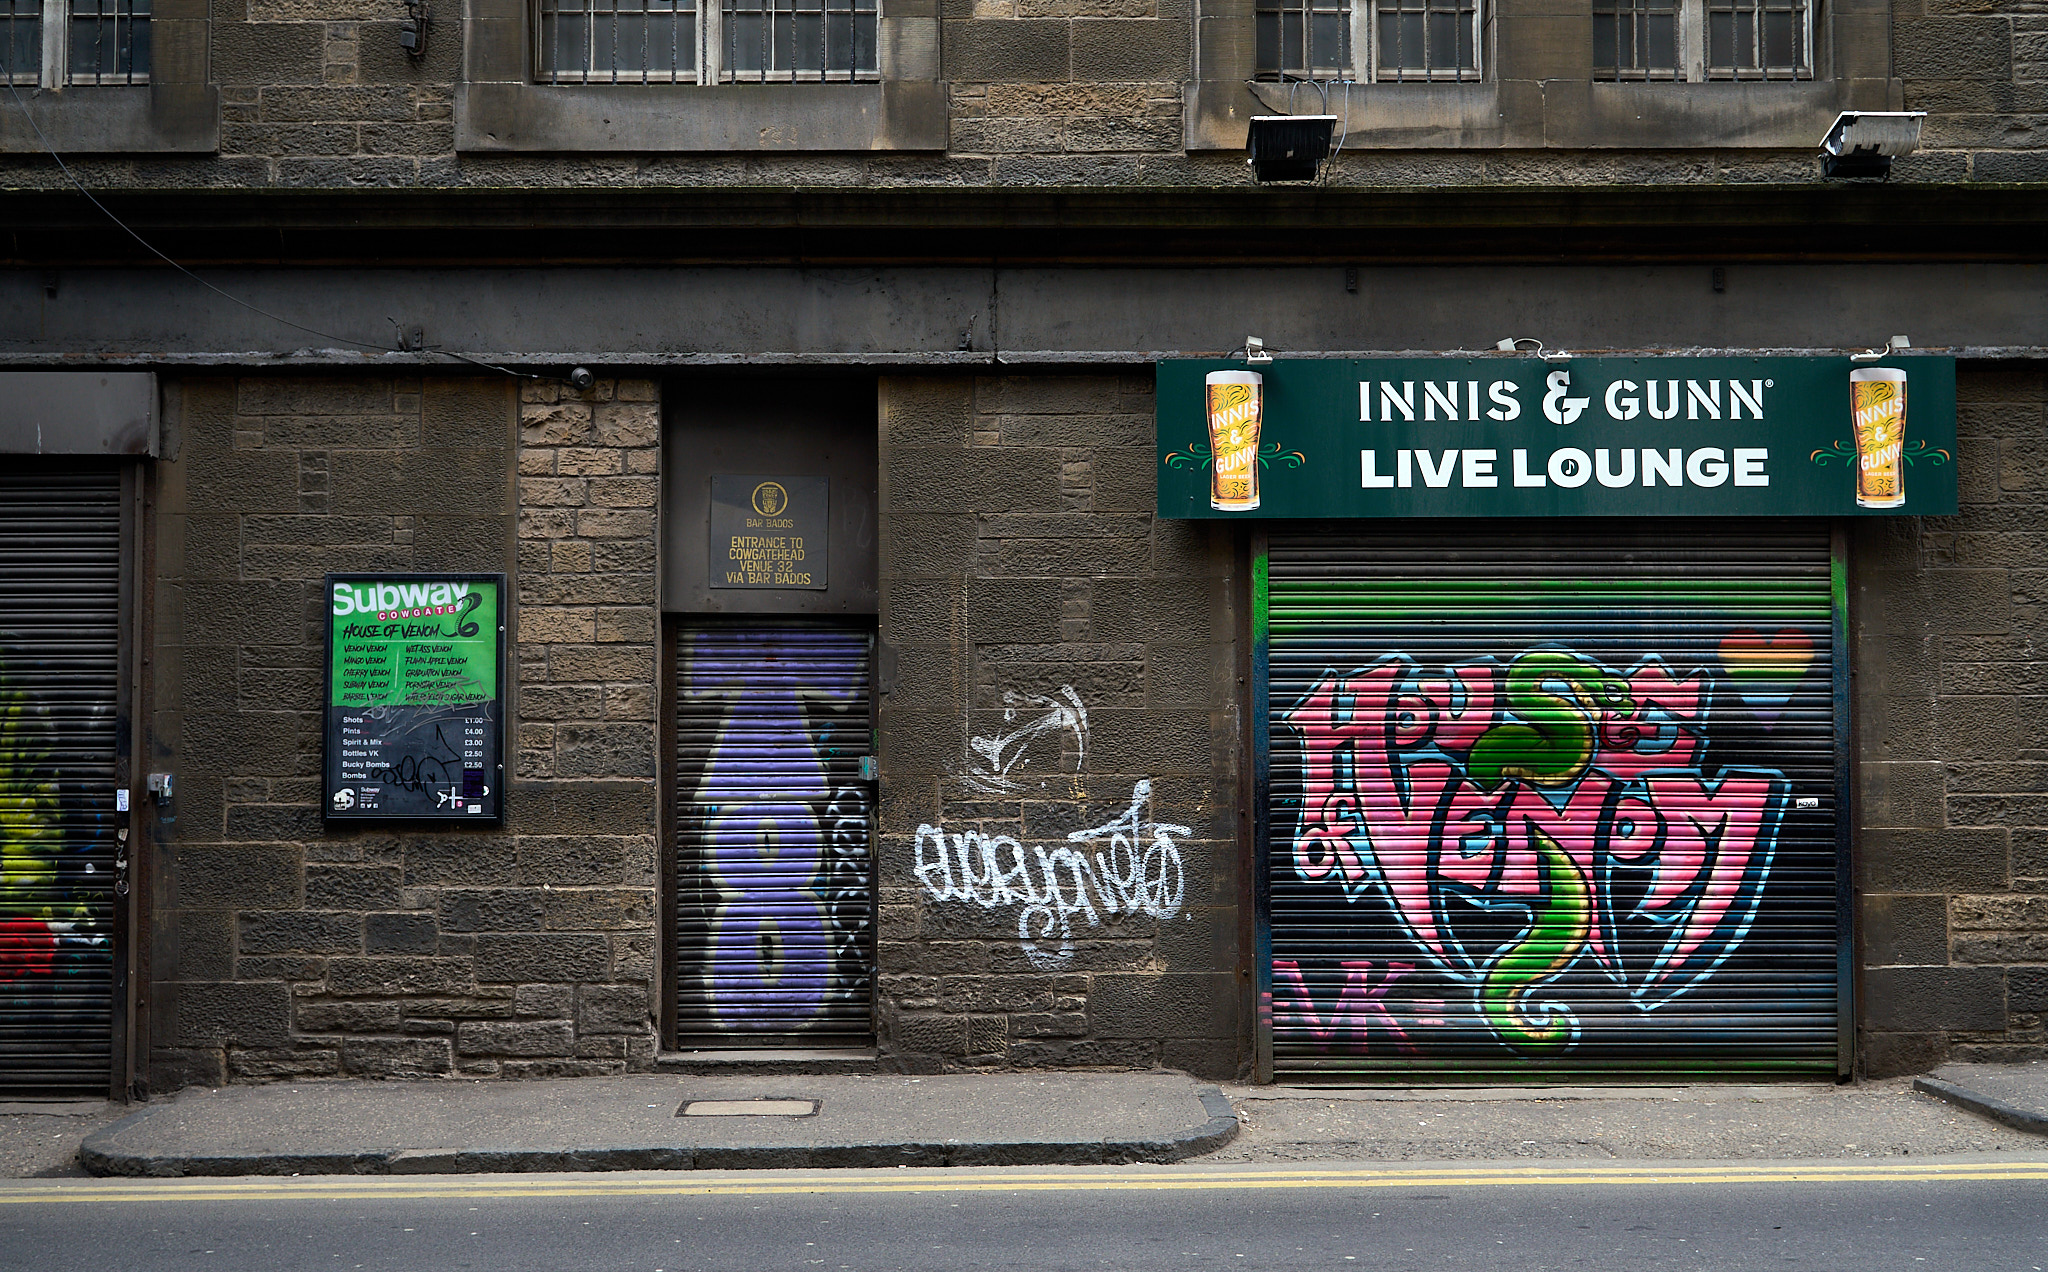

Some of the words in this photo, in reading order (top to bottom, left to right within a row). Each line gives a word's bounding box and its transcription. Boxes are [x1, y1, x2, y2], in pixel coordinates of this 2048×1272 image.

[1359, 380, 1521, 421] INNIS
[1543, 371, 1590, 426] &
[1211, 400, 1259, 430] INNIS
[1856, 397, 1903, 427] INNIS
[1229, 429, 1243, 445] &
[1874, 426, 1888, 442] &
[1215, 445, 1256, 473] GUNN
[1860, 442, 1901, 471] GUNN
[1361, 448, 1499, 488] LIVE
[1513, 447, 1770, 489] LOUNGE
[746, 518, 763, 528] BAR
[766, 519, 794, 528] BADOS
[731, 536, 786, 549] ENTRANCE
[789, 537, 803, 549] TO
[729, 548, 805, 561] COWGATEHEAD
[740, 560, 774, 572] VENUE
[777, 561, 793, 573] 32
[748, 573, 771, 584] BAR
[775, 573, 811, 585] BADOS
[333, 581, 469, 615] Subway
[378, 604, 457, 621] COWGATE
[343, 622, 382, 639] HOUSE
[383, 624, 399, 638] OF
[400, 622, 440, 640] VENOM
[344, 644, 366, 653] VENOM
[366, 644, 388, 653] VENOM
[431, 644, 453, 653] VENOM
[344, 656, 365, 665] MANGO
[365, 656, 387, 665] VENOM
[447, 656, 468, 665] VENOM
[343, 668, 369, 678] CHERRY
[369, 668, 391, 677] VENOM
[441, 668, 462, 677] VENOM
[343, 680, 367, 690] SUBWAY
[367, 680, 389, 689] VENOM
[366, 692, 388, 701] VENOM
[465, 692, 486, 701] VENOM
[343, 716, 364, 724] Shots
[464, 717, 483, 725] £1.00
[343, 727, 361, 735] Pints
[464, 728, 483, 736] £4.00
[342, 738, 361, 747] Spirit
[363, 738, 369, 746] &
[370, 738, 382, 746] Mix
[464, 739, 483, 747] £3.00
[342, 749, 367, 757] Bottles
[368, 749, 379, 757] VK
[464, 750, 483, 758] £2.50
[342, 761, 364, 770] Bucky
[365, 760, 390, 768] Bombs
[464, 761, 483, 769] £2.50
[342, 772, 367, 780] Bombs
